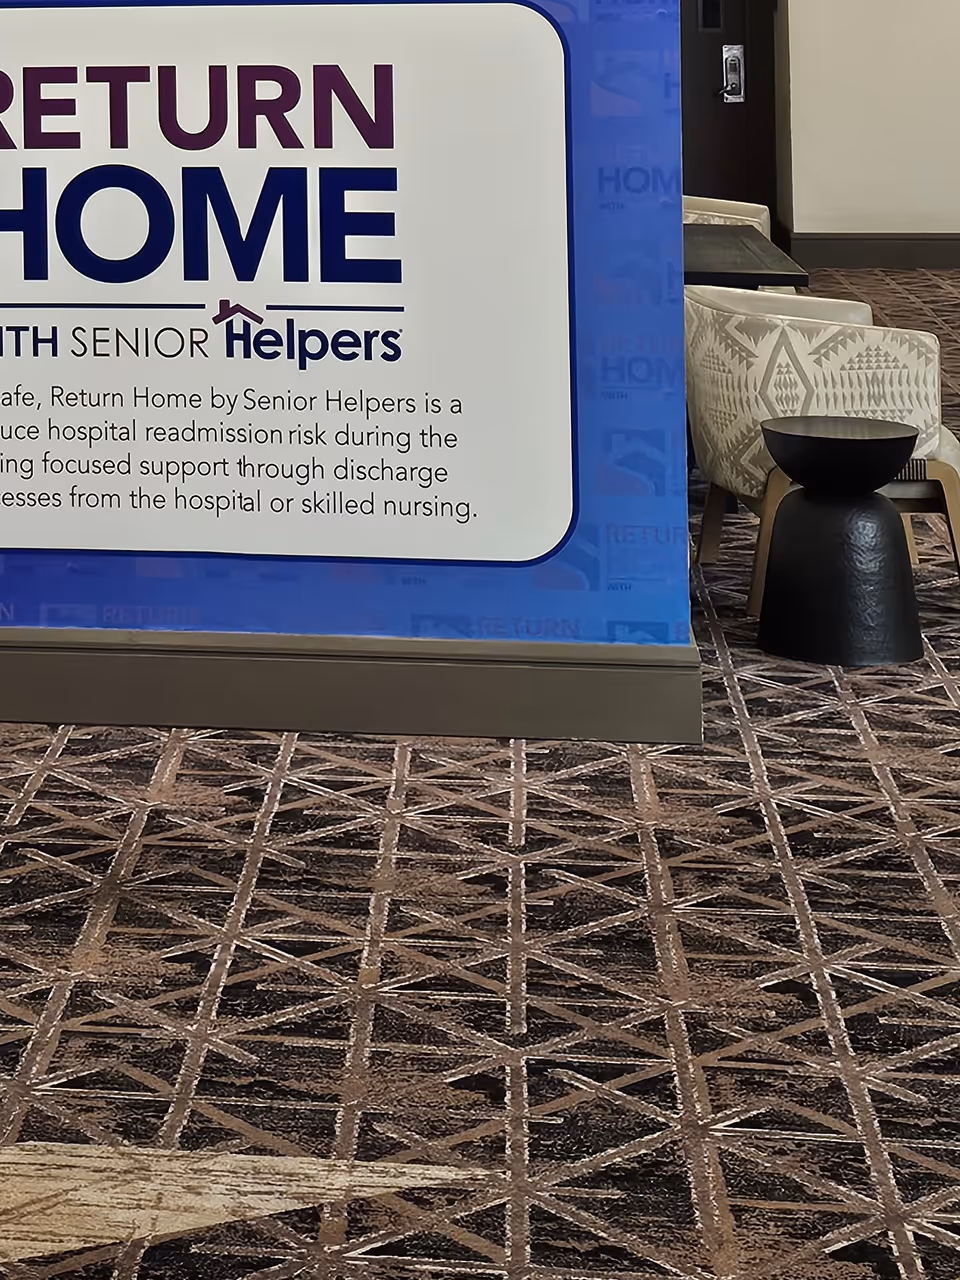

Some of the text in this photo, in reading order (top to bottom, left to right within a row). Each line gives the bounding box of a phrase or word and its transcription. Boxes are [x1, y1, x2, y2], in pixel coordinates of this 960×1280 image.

[70, 326, 209, 359] SENIOR
[225, 318, 403, 371] Helpers
[50, 385, 125, 409] Return
[133, 386, 203, 409] Home
[210, 385, 239, 416] by
[243, 387, 319, 412] Senior
[325, 388, 417, 421] Helpers
[424, 391, 442, 414] is
[449, 398, 463, 415] a
[47, 416, 136, 449] hospital
[145, 419, 283, 445] readmission
[288, 421, 328, 447] risk
[334, 422, 411, 454] during
[418, 424, 458, 449] the
[40, 450, 132, 476] focused
[139, 457, 230, 484] support
[235, 454, 325, 486] through
[333, 456, 449, 489] discharge
[67, 483, 121, 509] from
[127, 485, 168, 510] the
[174, 486, 261, 519] hospital
[269, 496, 296, 514] or
[301, 489, 375, 516] skilled
[383, 494, 478, 525] nursing.
